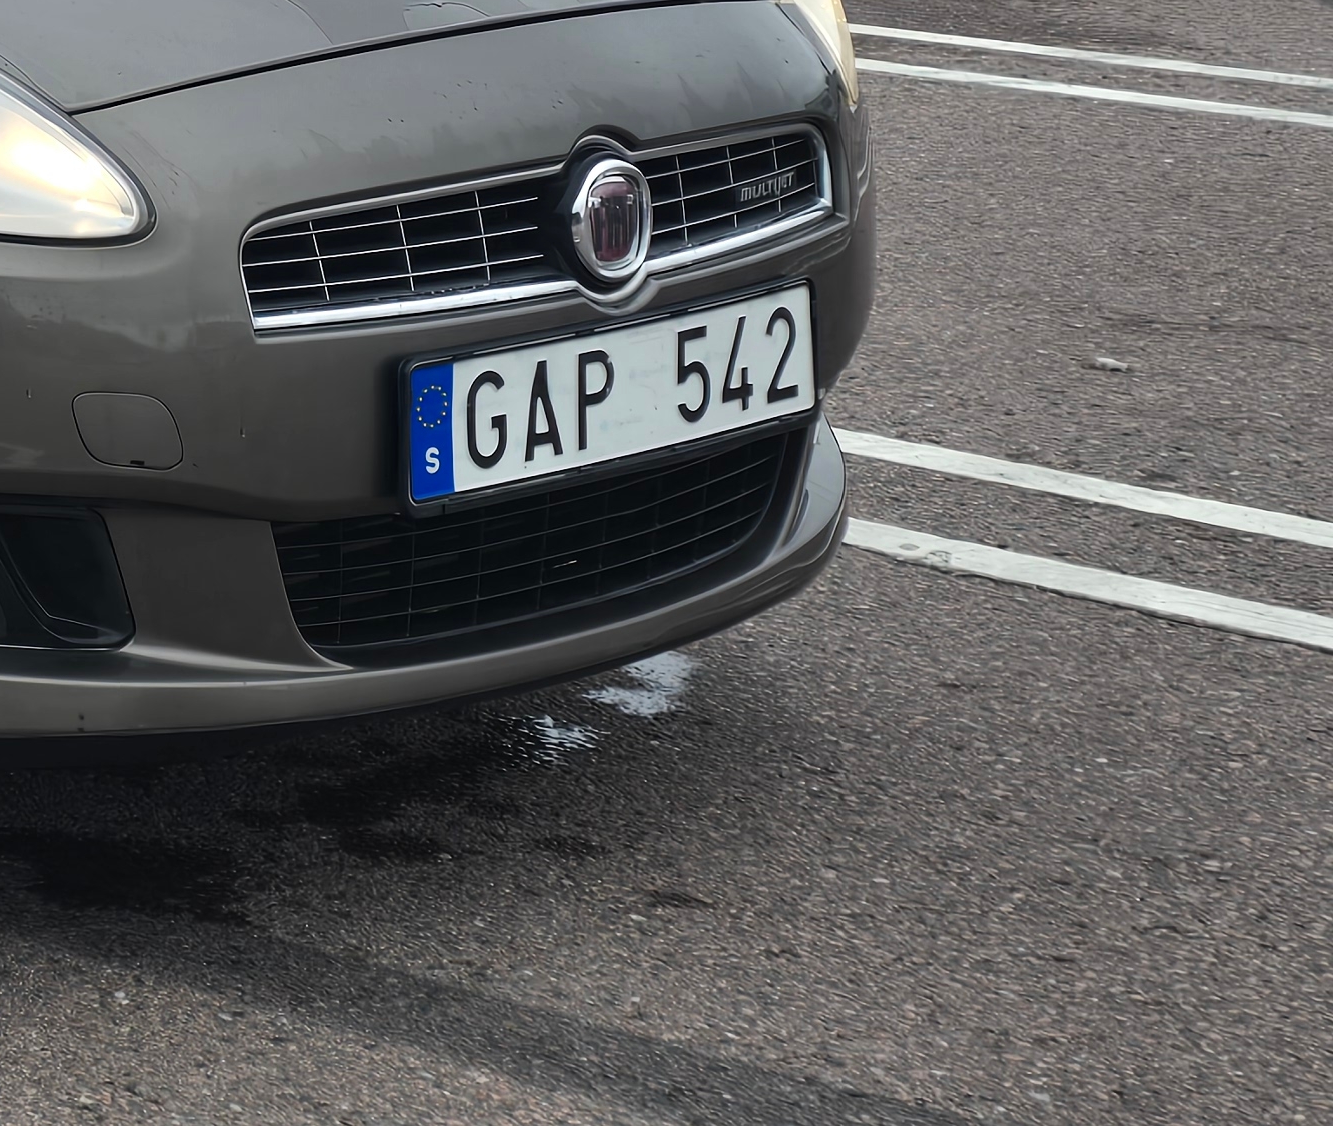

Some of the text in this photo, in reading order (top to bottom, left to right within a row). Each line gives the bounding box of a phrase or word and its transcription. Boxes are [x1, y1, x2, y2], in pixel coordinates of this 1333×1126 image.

[467, 307, 799, 469] GAP 542
[425, 447, 440, 474] S
